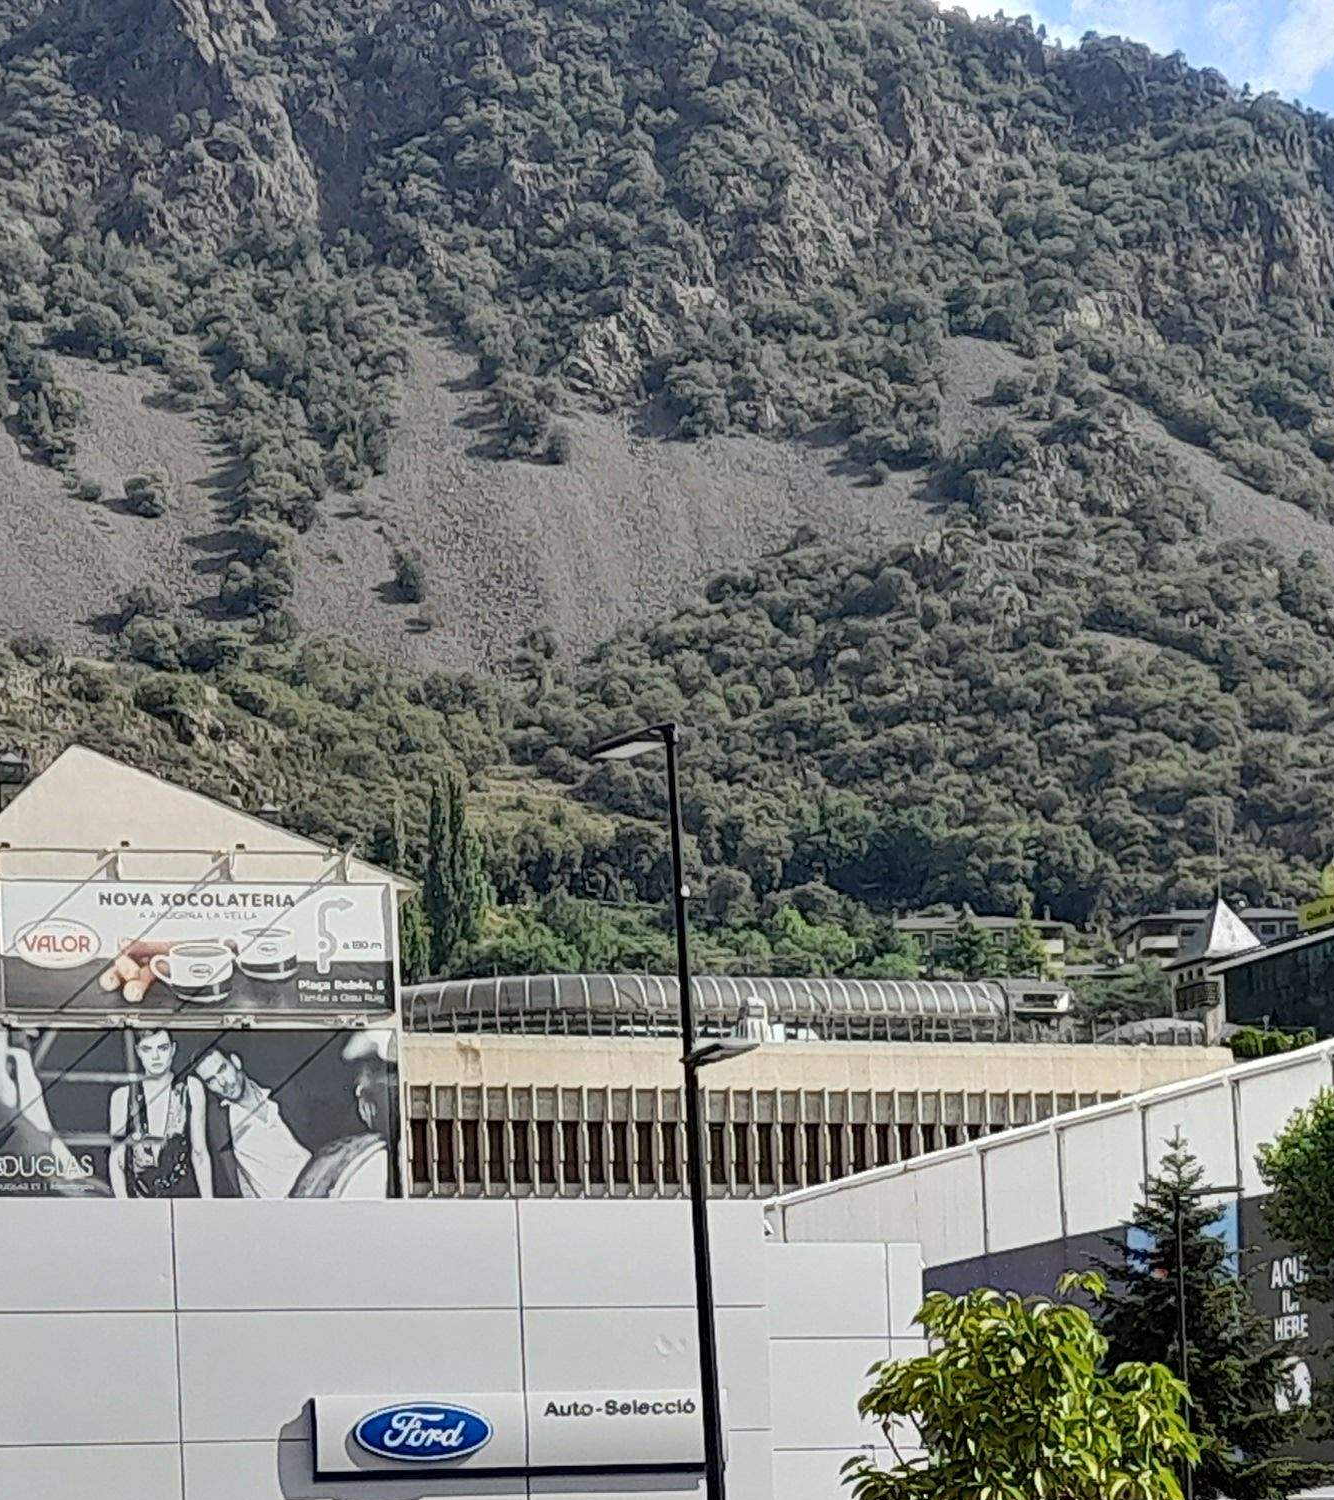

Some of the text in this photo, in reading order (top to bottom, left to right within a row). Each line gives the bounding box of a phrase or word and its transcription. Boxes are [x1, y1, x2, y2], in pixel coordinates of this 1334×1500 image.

[98, 891, 295, 908] NOVA XOCOLATERIA
[23, 934, 92, 952] VALOR
[1270, 1254, 1309, 1289] AQU
[1274, 1313, 1308, 1341] HERE
[544, 1398, 696, 1417] Auto-Selecció
[383, 1411, 466, 1448] Ford
